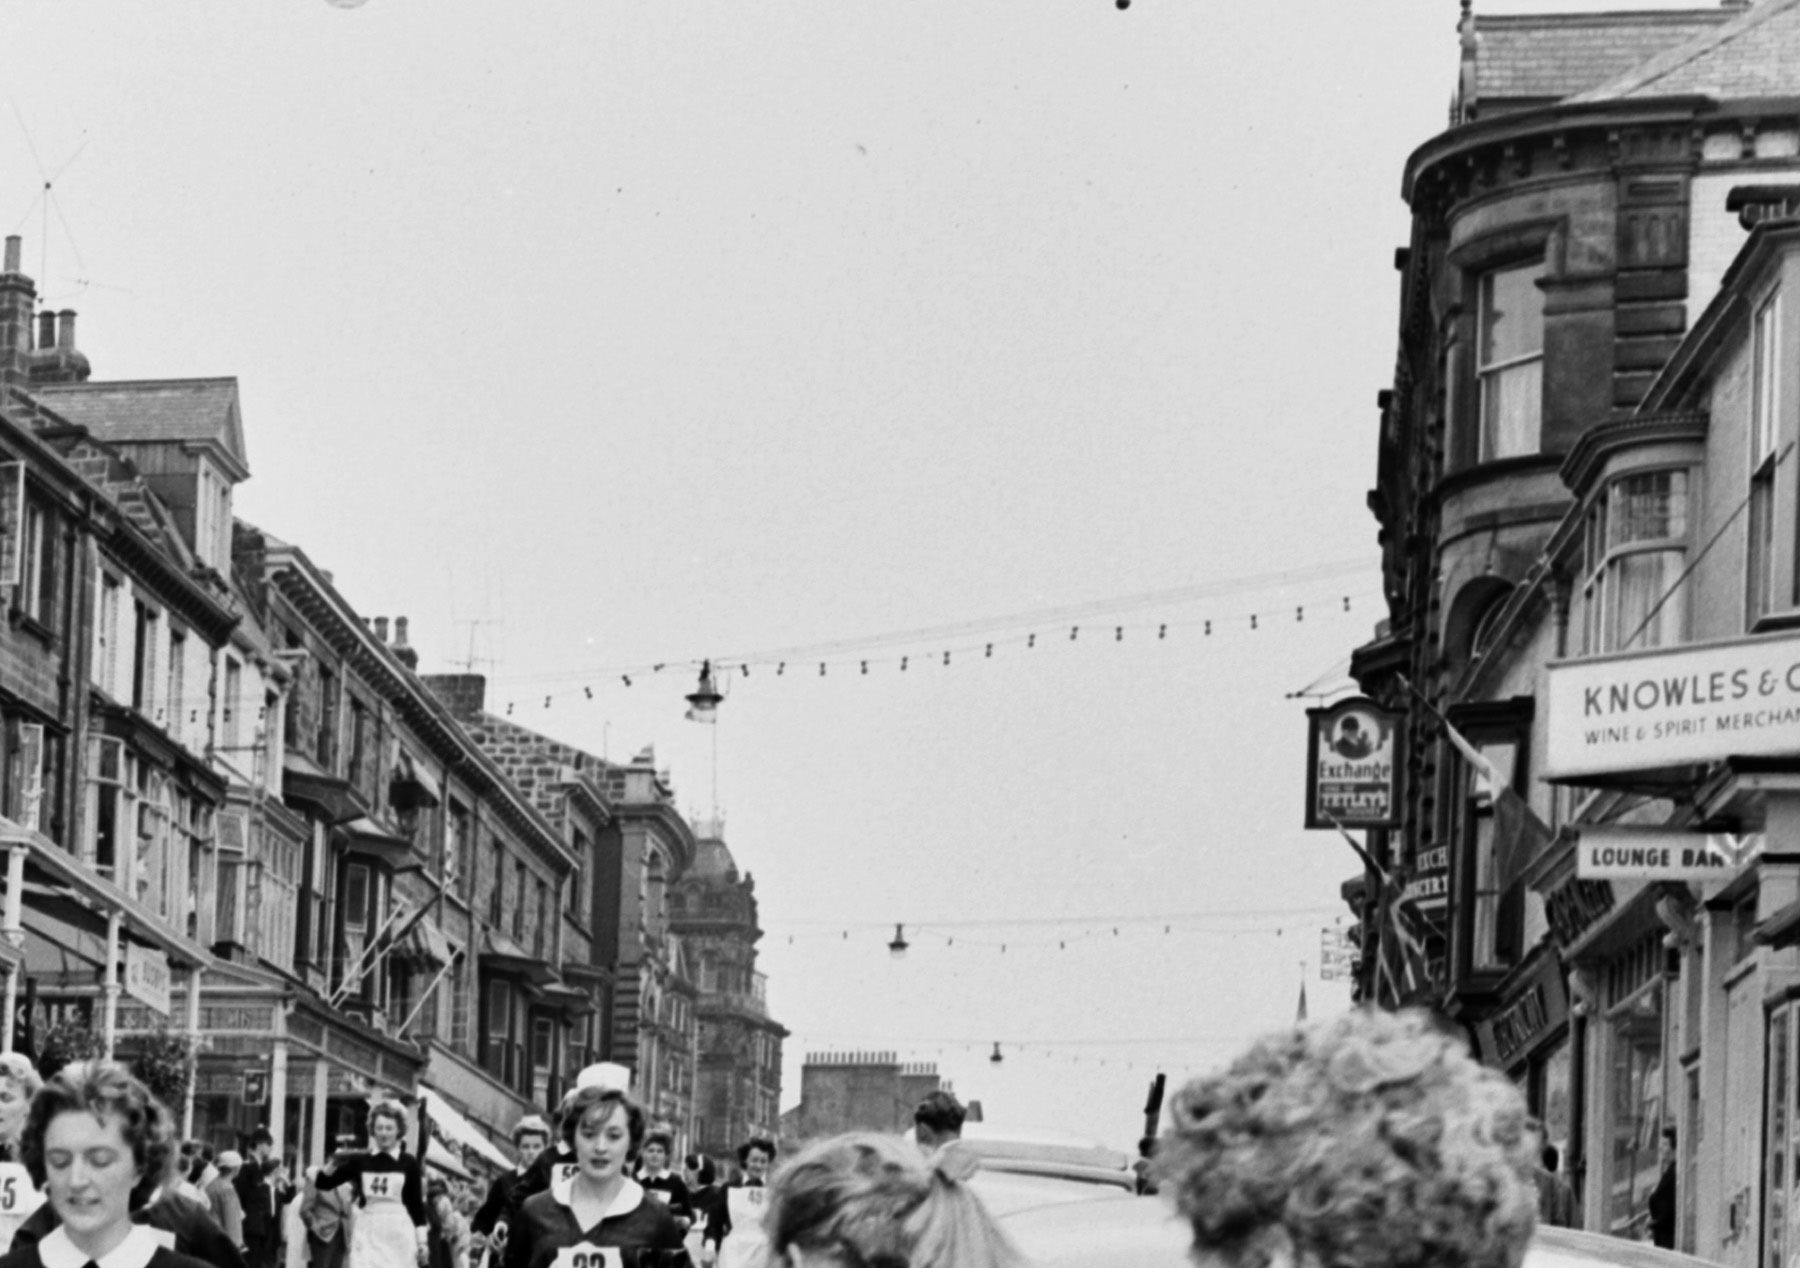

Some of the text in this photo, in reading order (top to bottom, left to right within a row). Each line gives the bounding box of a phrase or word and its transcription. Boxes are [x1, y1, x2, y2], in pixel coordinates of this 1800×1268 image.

[1584, 669, 1749, 717] KNOWLES
[1758, 669, 1779, 697] &
[1585, 727, 1630, 746] WINE
[1653, 717, 1707, 740] SPIRIT
[1320, 761, 1390, 782] Exchange
[1592, 848, 1670, 867] LOUNGE
[370, 1176, 388, 1196] 44
